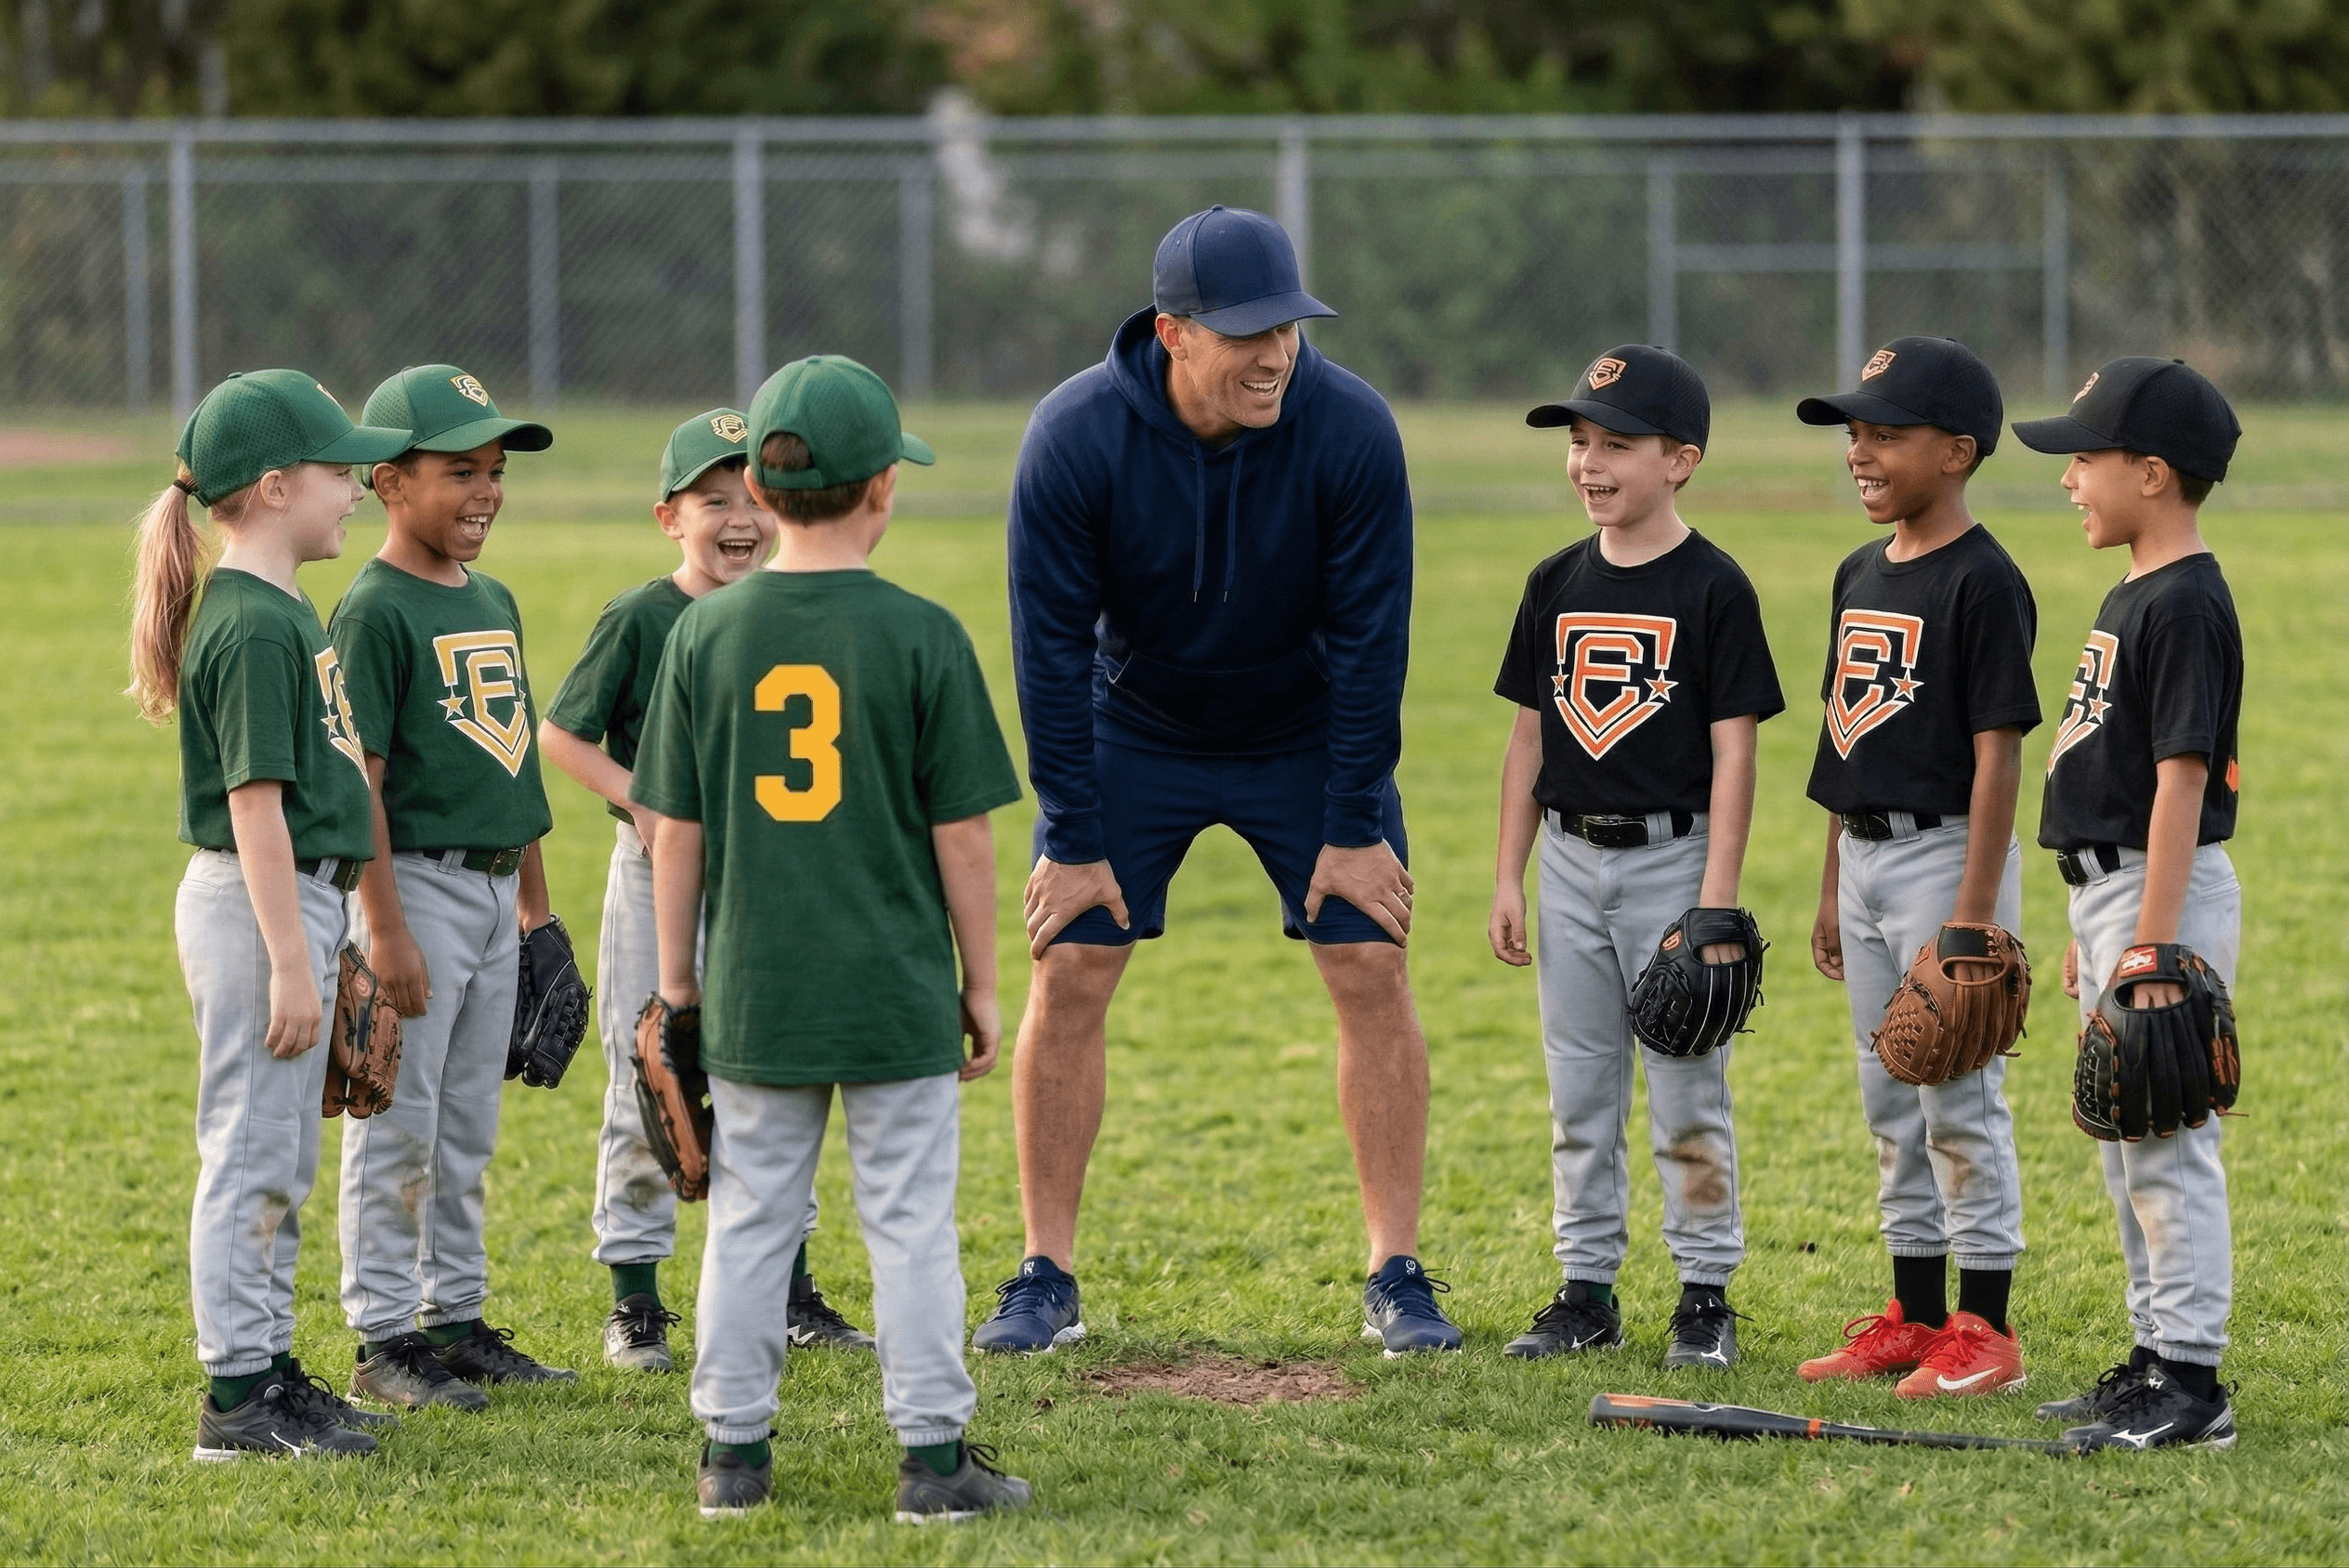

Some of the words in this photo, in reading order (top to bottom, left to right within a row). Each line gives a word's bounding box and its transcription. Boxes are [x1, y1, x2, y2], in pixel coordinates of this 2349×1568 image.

[466, 649, 526, 753] E
[1570, 633, 1644, 736] E
[1833, 630, 1892, 736] E
[755, 664, 842, 821] 3
